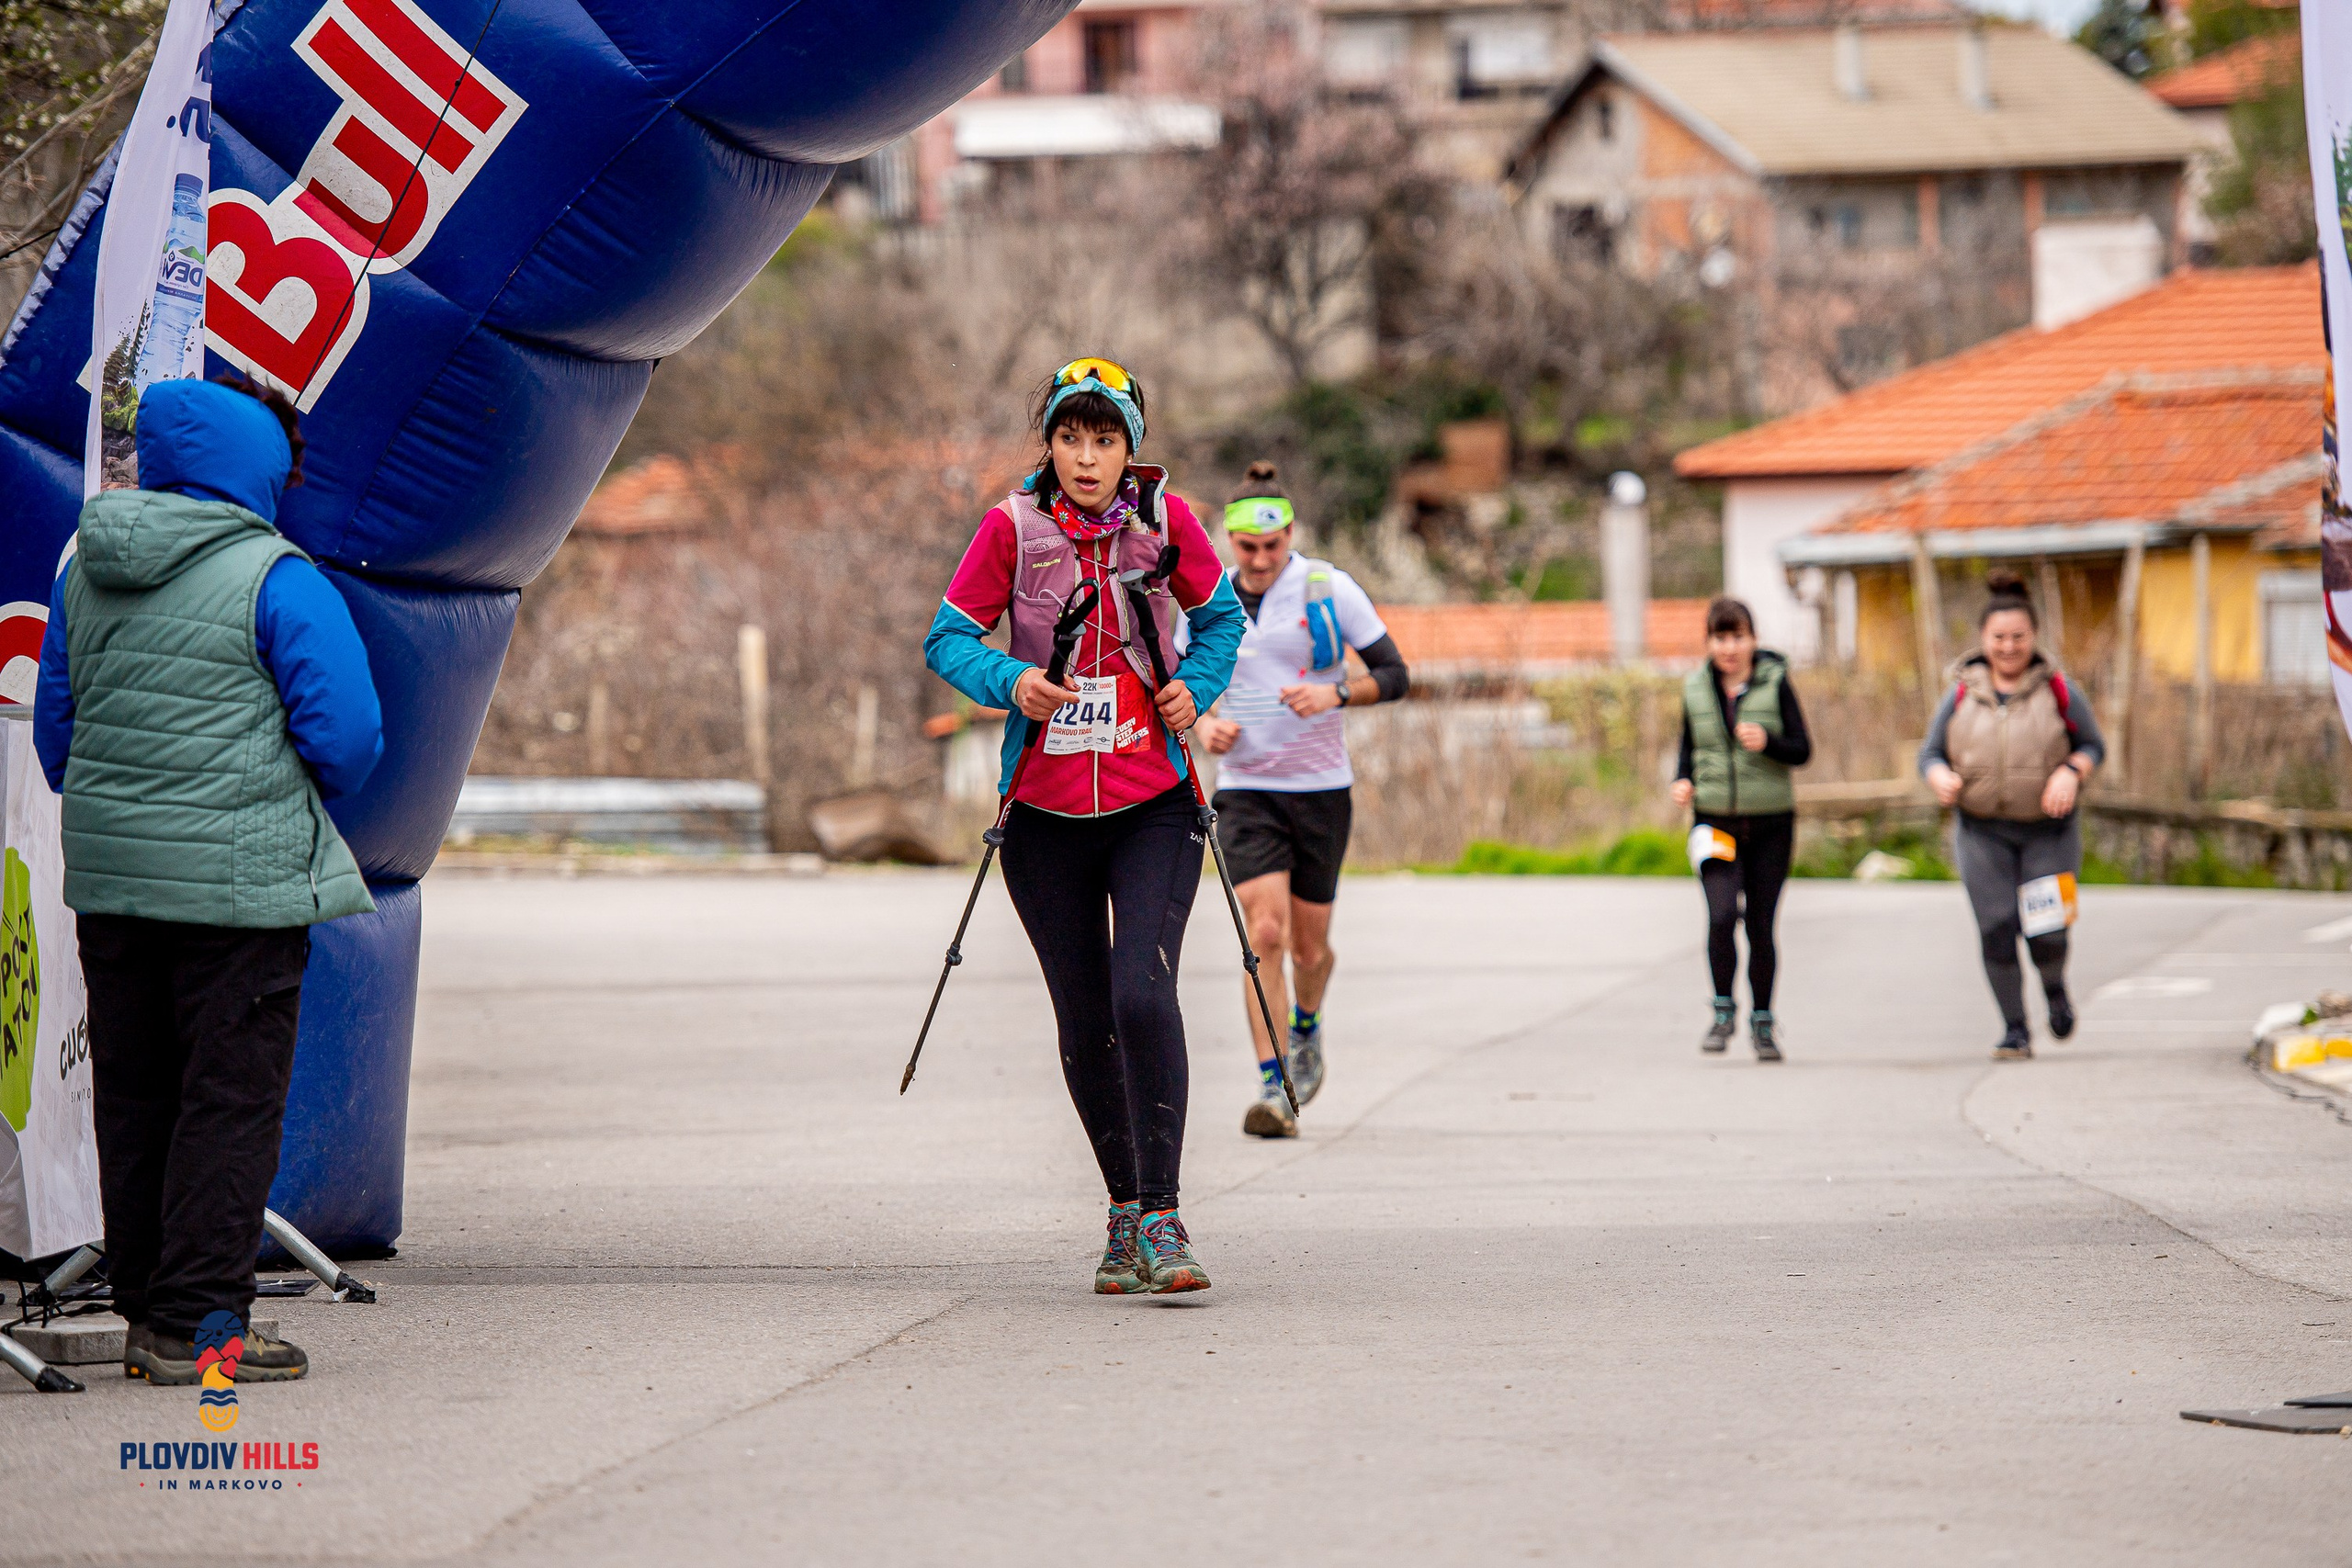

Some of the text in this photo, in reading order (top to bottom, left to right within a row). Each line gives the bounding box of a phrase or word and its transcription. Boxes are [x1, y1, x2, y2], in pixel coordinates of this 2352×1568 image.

[204, 0, 514, 400] Bull
[1032, 558, 1061, 569] SALOMON
[1082, 682, 1097, 692] 22K
[1053, 702, 1112, 725] 2244
[1049, 726, 1093, 736] MARKOVO TRAIL
[1115, 727, 1134, 742] STEP
[1116, 727, 1149, 749] MATTERS
